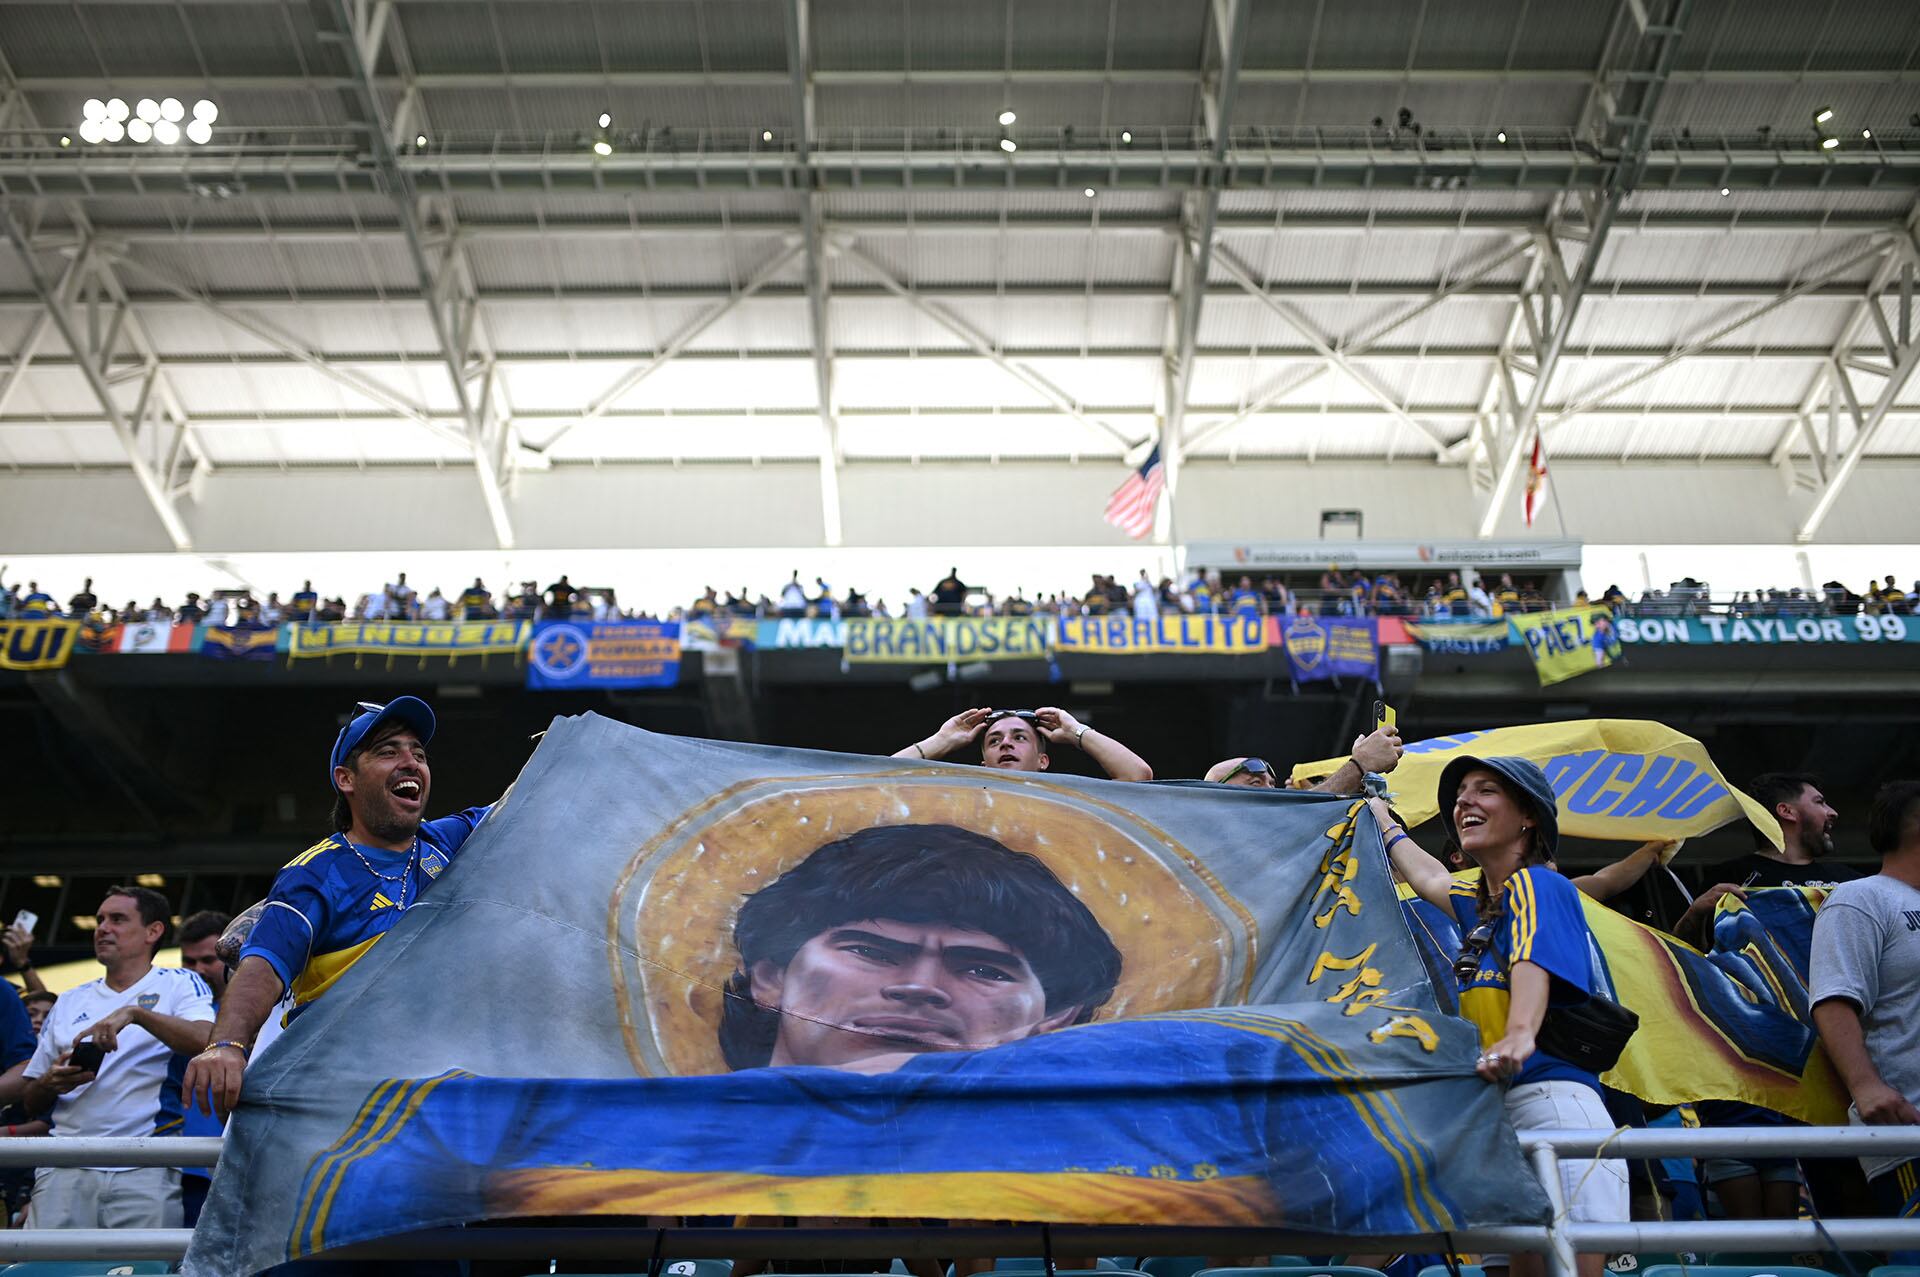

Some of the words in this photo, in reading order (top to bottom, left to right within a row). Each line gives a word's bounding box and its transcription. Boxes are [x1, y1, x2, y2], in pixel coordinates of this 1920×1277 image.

[850, 620, 1047, 656] BRANDSEN
[1059, 616, 1263, 647] CABALLITO
[1701, 615, 1846, 642] TAYLOR
[1855, 614, 1907, 641] 99
[1616, 1255, 1632, 1269] 14
